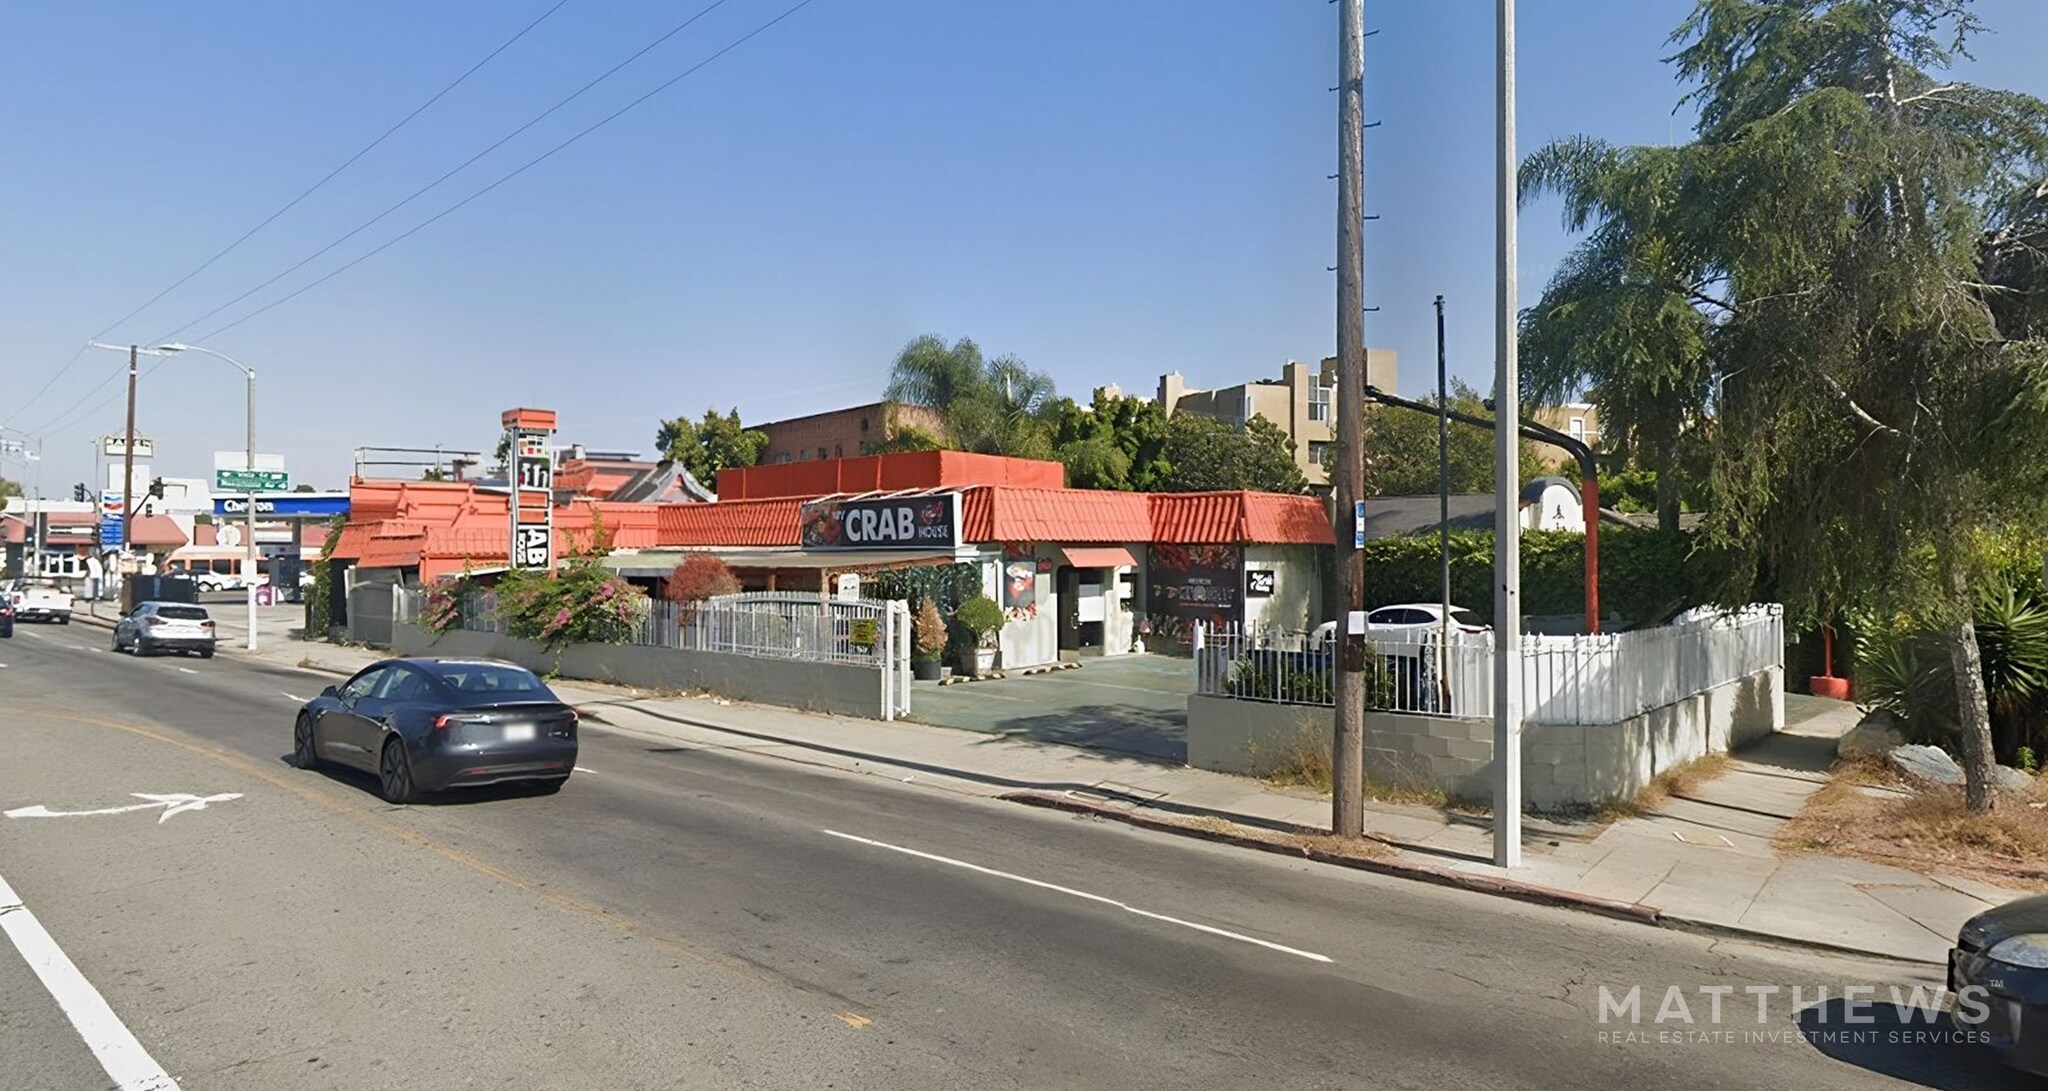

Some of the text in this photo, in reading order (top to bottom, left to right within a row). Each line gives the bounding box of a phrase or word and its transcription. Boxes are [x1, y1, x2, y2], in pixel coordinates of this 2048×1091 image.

[224, 500, 274, 512] Chevon
[845, 507, 915, 542] CRAB
[918, 524, 949, 539] HOUSE
[527, 529, 547, 565] AB
